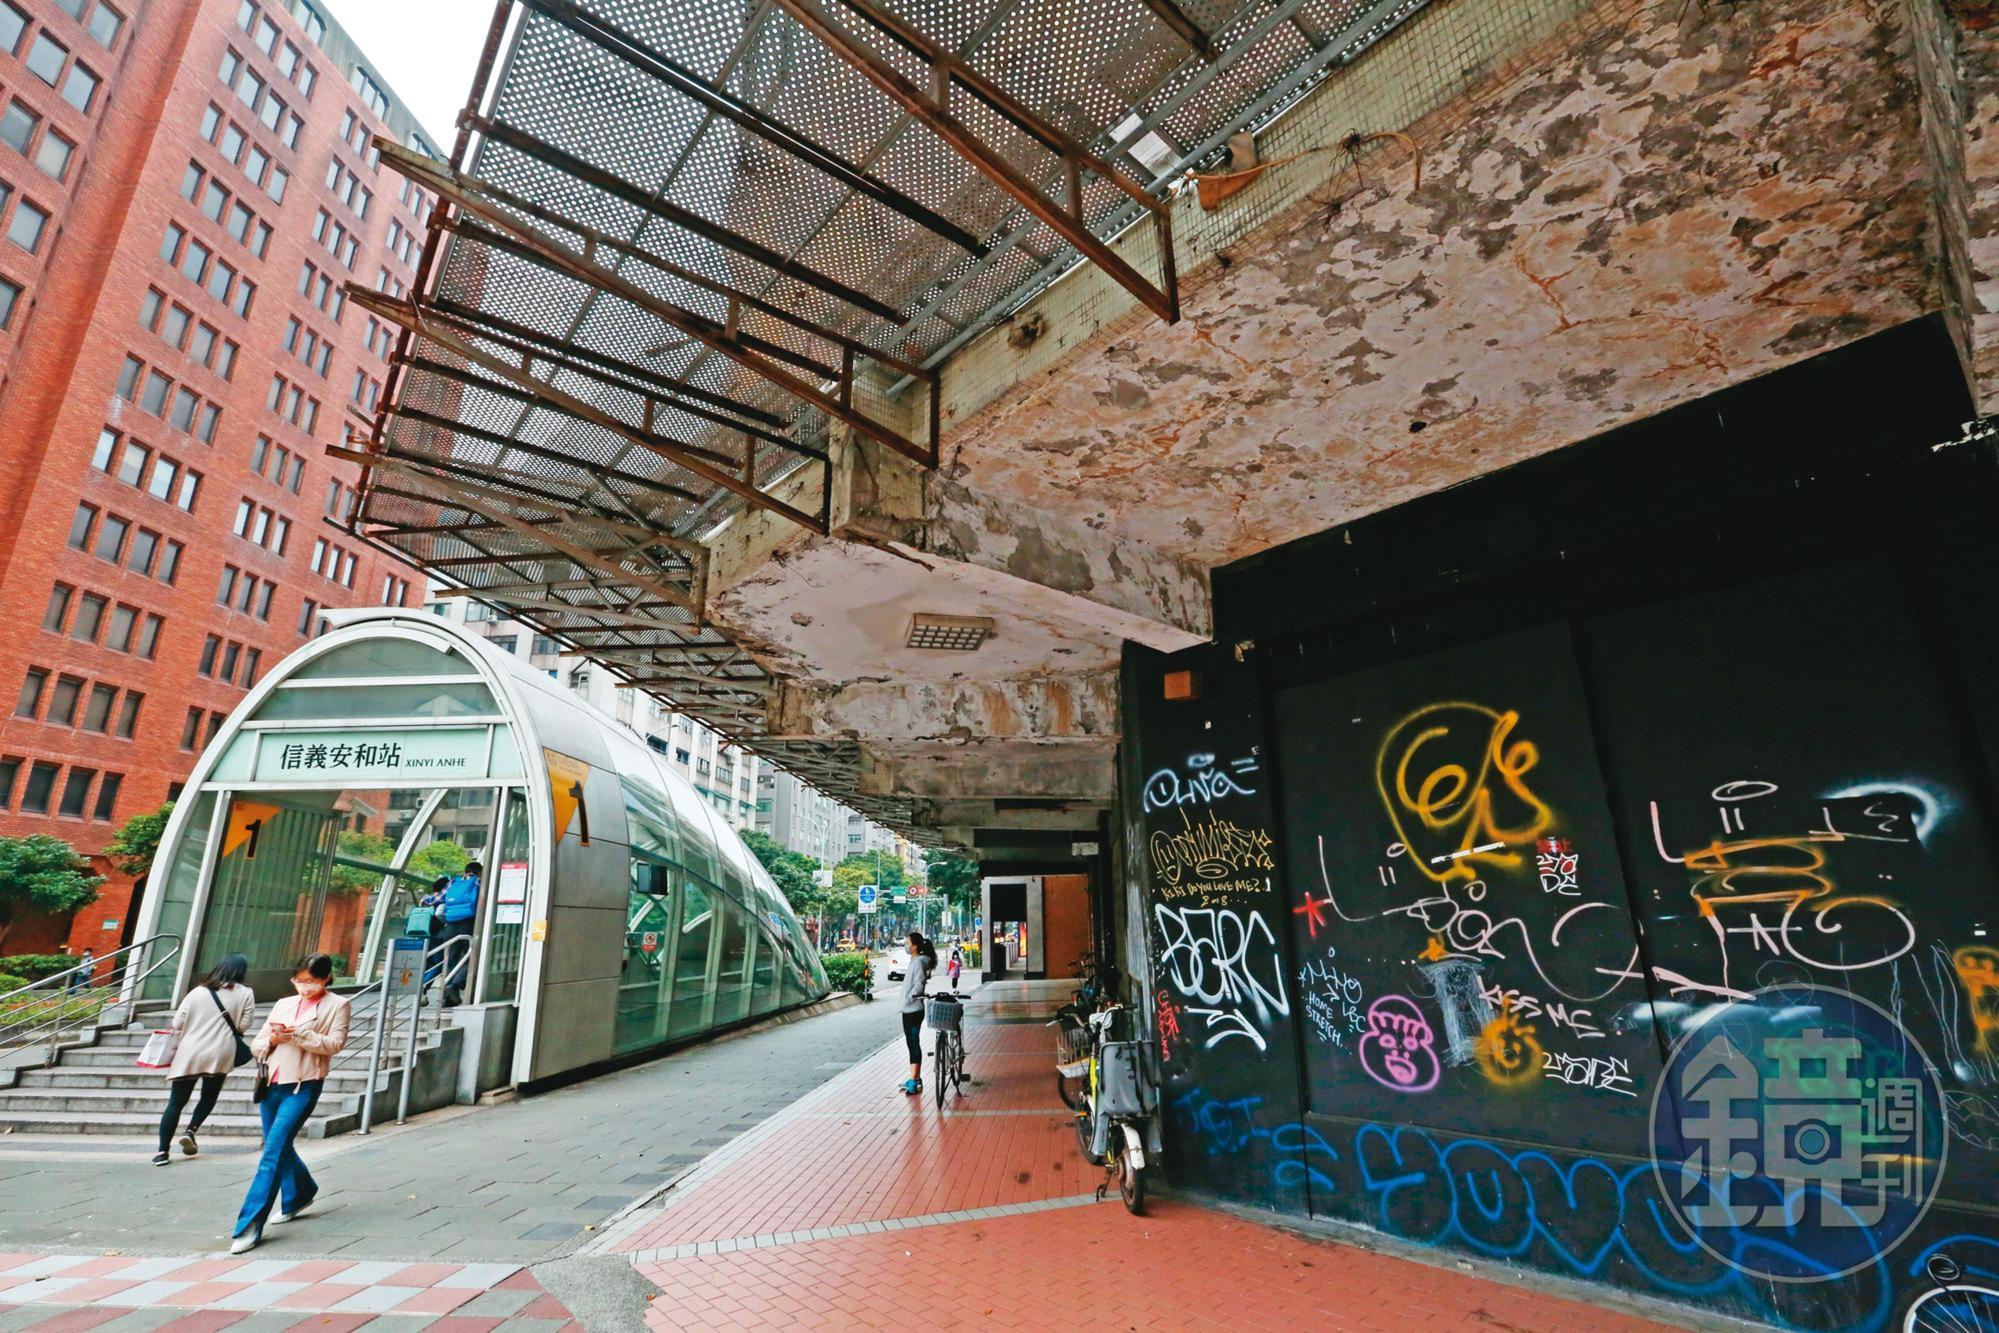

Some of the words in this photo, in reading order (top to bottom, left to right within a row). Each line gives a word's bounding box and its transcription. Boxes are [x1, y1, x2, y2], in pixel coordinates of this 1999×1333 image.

[280, 743, 401, 770] 信義安和站
[405, 758, 433, 767] XINYI
[437, 757, 467, 767] ANHE
[568, 780, 590, 846] 1
[245, 818, 262, 859] 1
